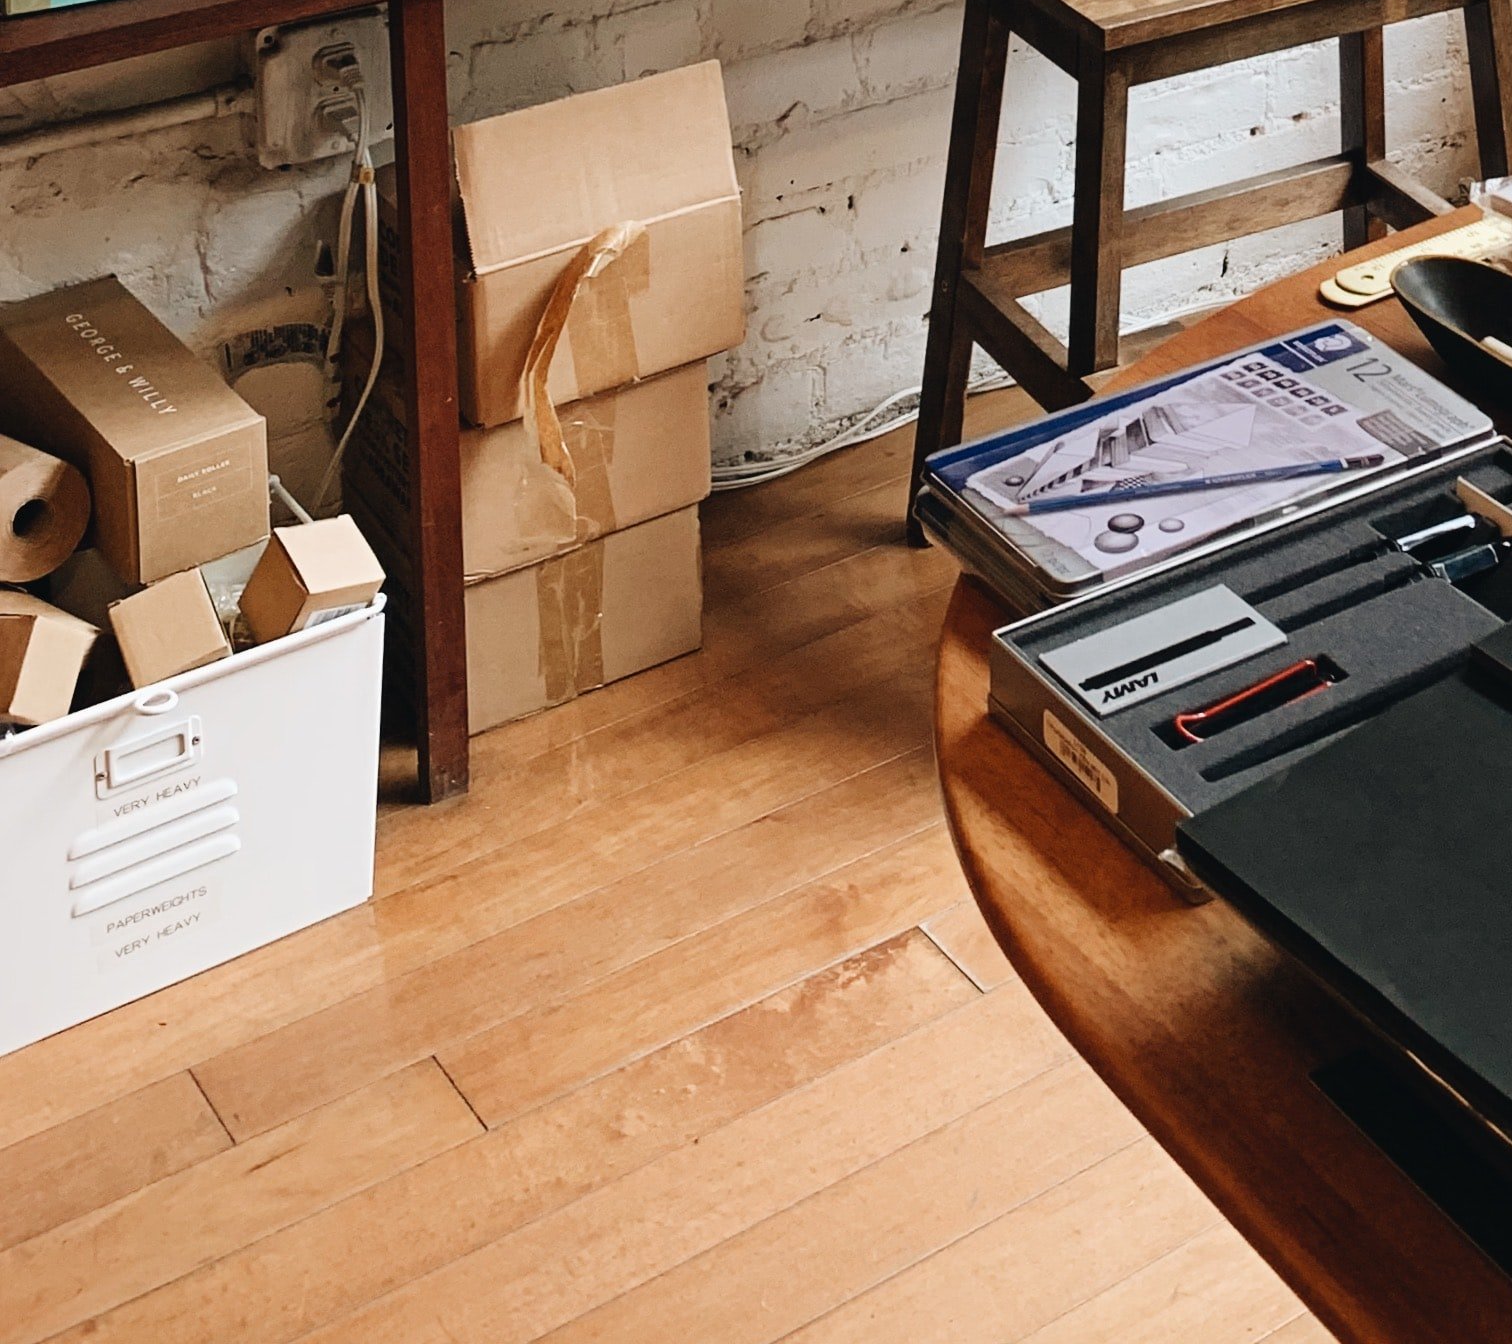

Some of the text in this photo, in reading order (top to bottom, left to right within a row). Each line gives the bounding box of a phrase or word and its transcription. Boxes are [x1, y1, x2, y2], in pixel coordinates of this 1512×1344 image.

[65, 313, 178, 415] GEORGE & WILLY
[1346, 357, 1393, 383] 12
[177, 470, 199, 484] DAILY
[1101, 671, 1160, 704] LAMY
[113, 775, 202, 818] VERY HEAVY
[106, 886, 208, 934] PAPERWEIGHTS
[114, 912, 201, 959] VERY HEAVY
